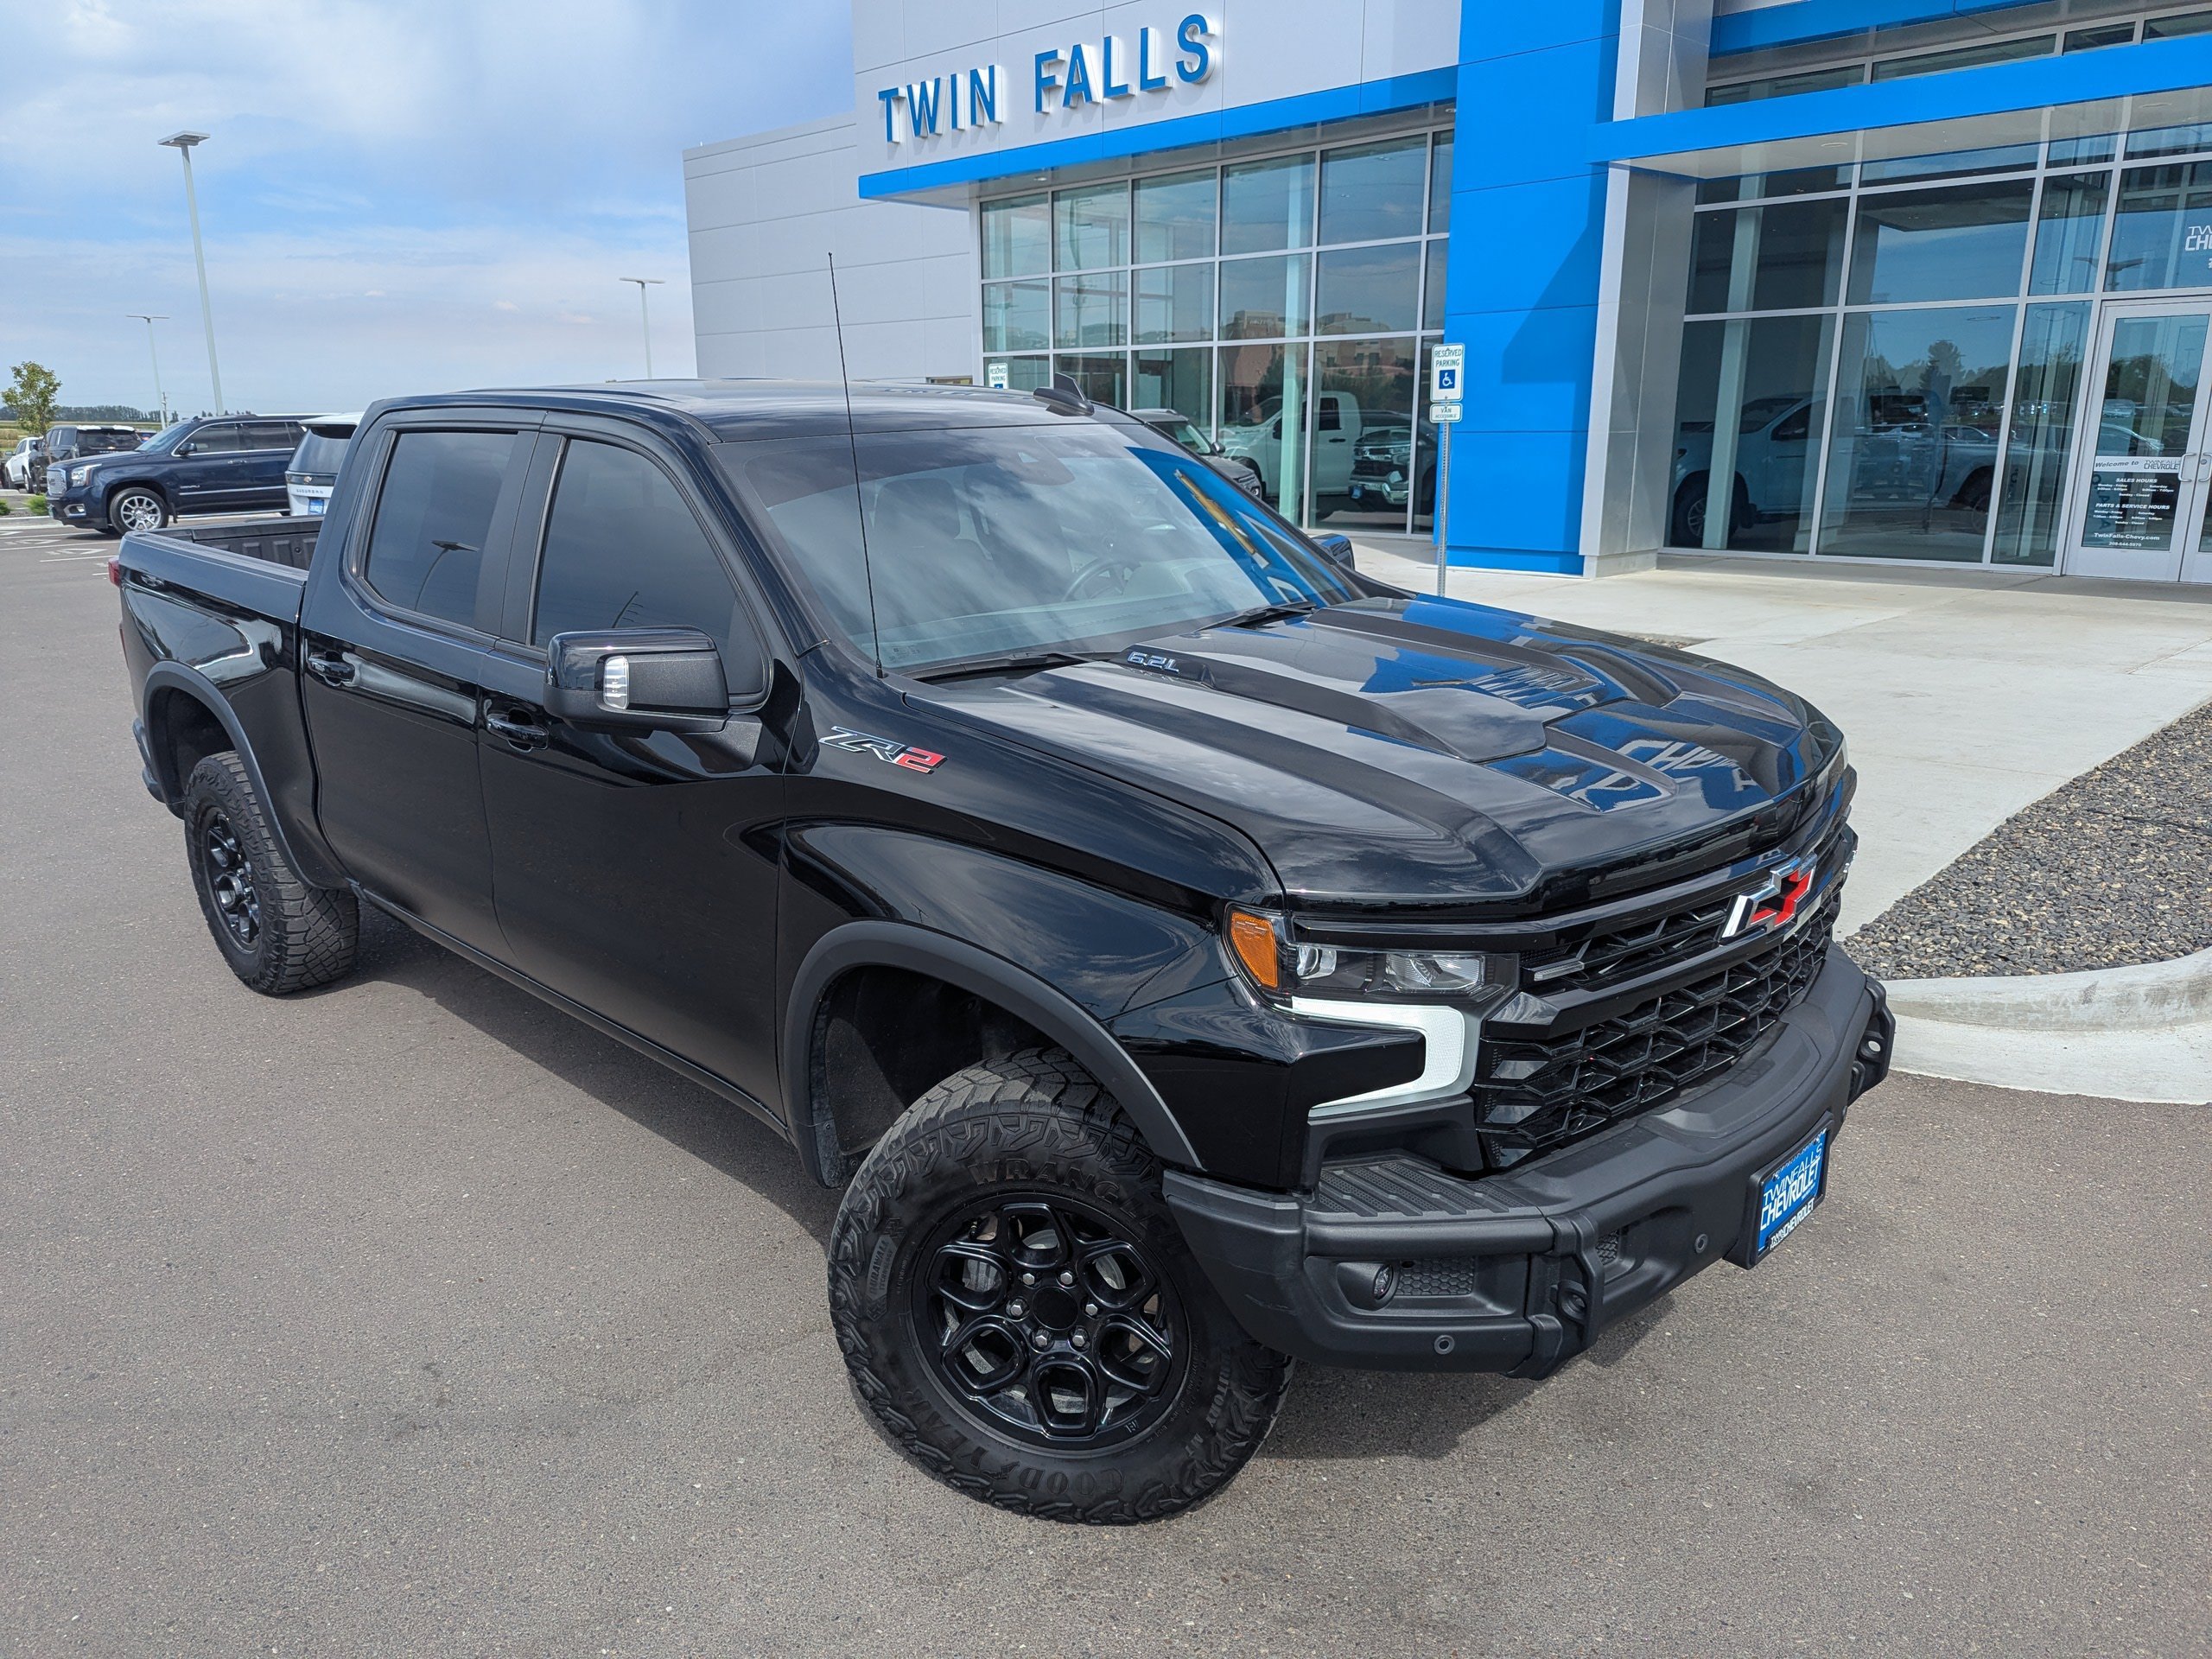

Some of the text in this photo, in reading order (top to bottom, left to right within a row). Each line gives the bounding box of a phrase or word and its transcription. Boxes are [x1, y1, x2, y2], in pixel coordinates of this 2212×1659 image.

[878, 13, 1215, 143] TWIN FALLS
[1434, 348, 1462, 358] RESERVED
[1435, 359, 1460, 367] PARKING
[1127, 651, 1179, 673] 6.2L
[818, 725, 948, 774] ZR2
[1760, 1158, 1821, 1231] CHEVROLET
[1783, 1197, 1815, 1237] CHEVROLET
